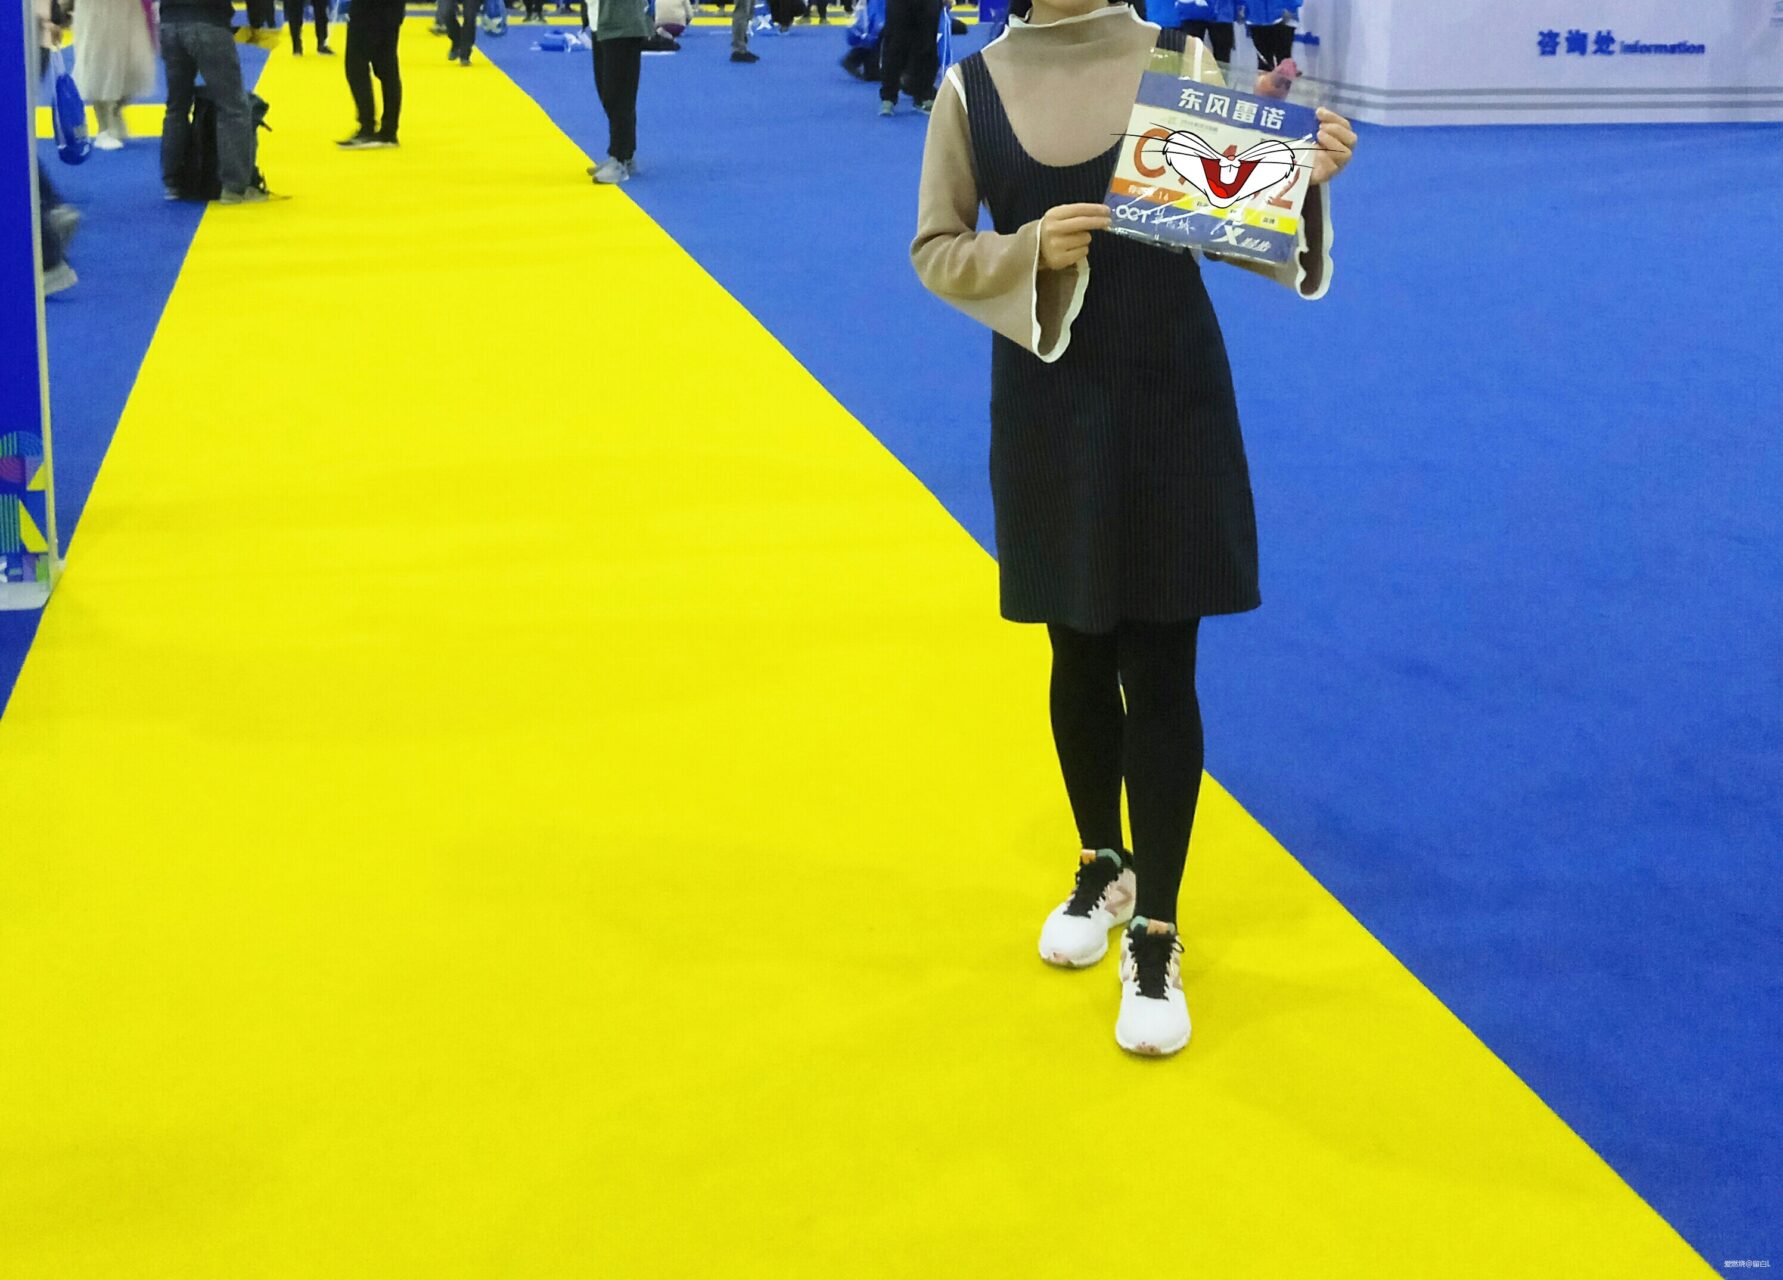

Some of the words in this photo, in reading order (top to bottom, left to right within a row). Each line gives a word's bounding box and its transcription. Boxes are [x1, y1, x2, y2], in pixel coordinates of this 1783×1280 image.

[1537, 29, 1616, 57] 咨询处
[1178, 88, 1286, 130] 东风雷诺
